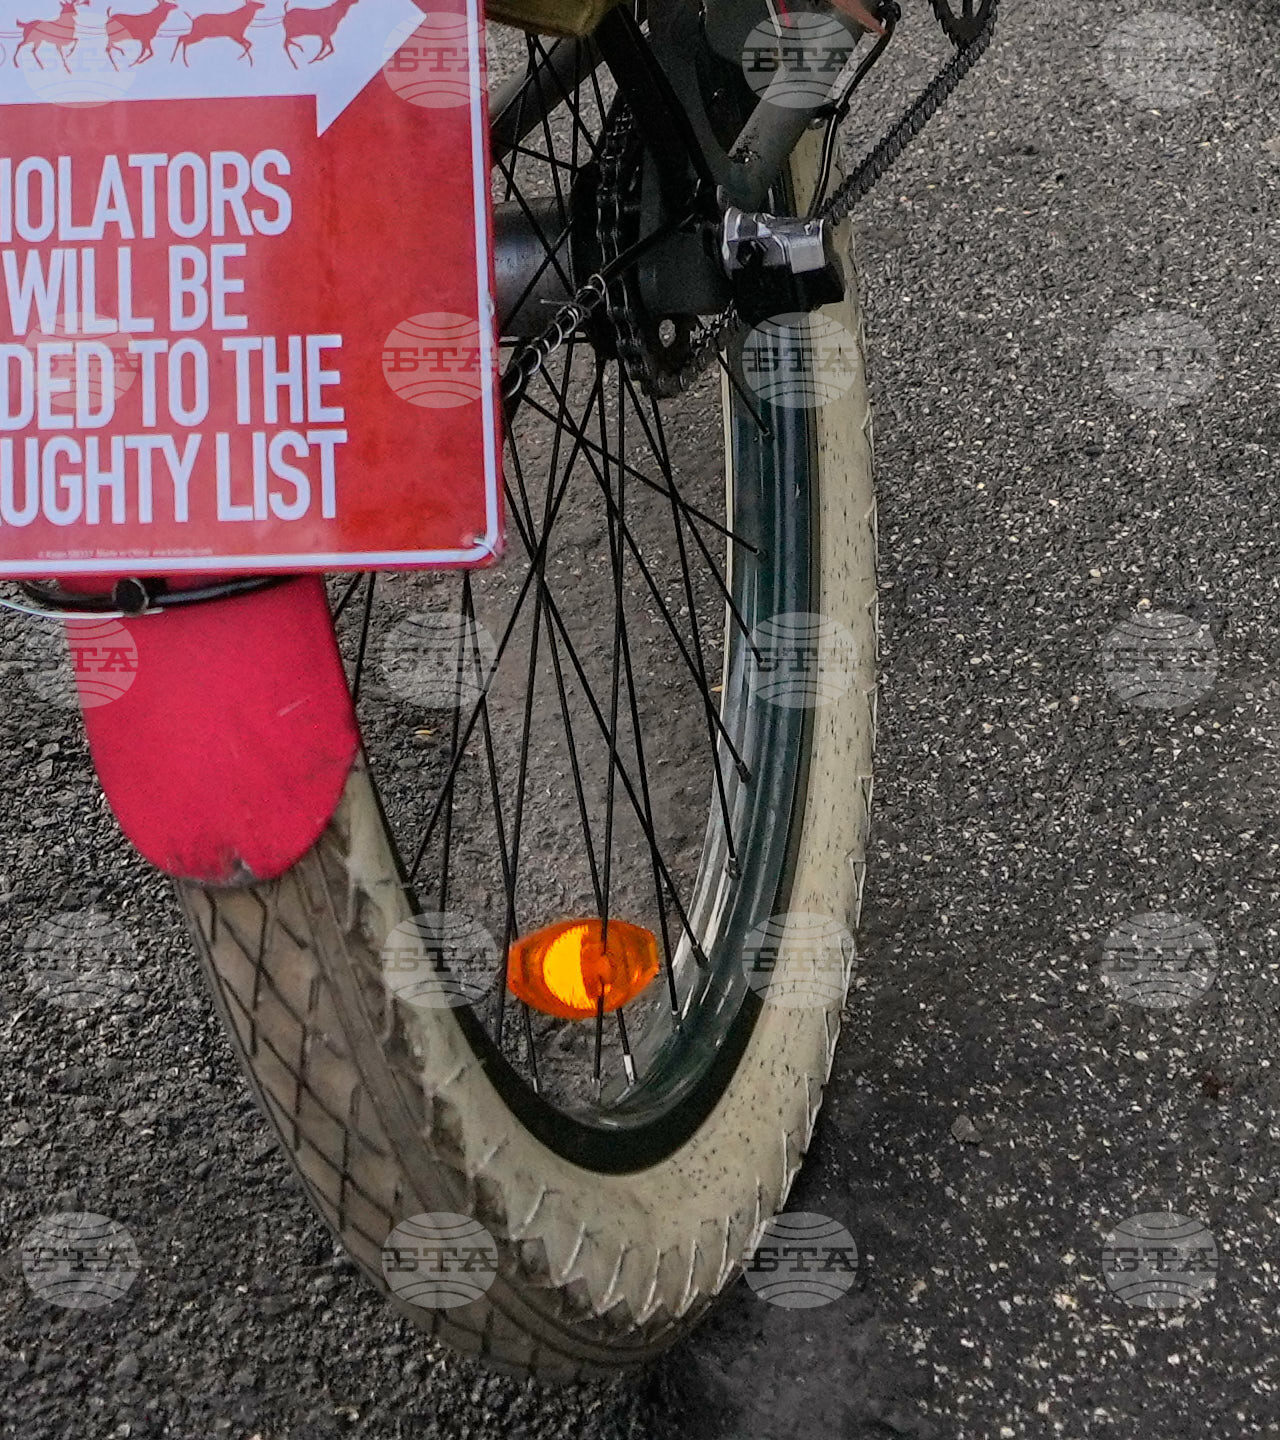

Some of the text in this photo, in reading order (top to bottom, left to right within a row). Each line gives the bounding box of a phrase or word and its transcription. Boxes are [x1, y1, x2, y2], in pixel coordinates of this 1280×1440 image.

[1, 243, 249, 336] WILL BE
[128, 338, 210, 428] TO
[222, 334, 346, 426] THE
[215, 429, 348, 522] LIST
